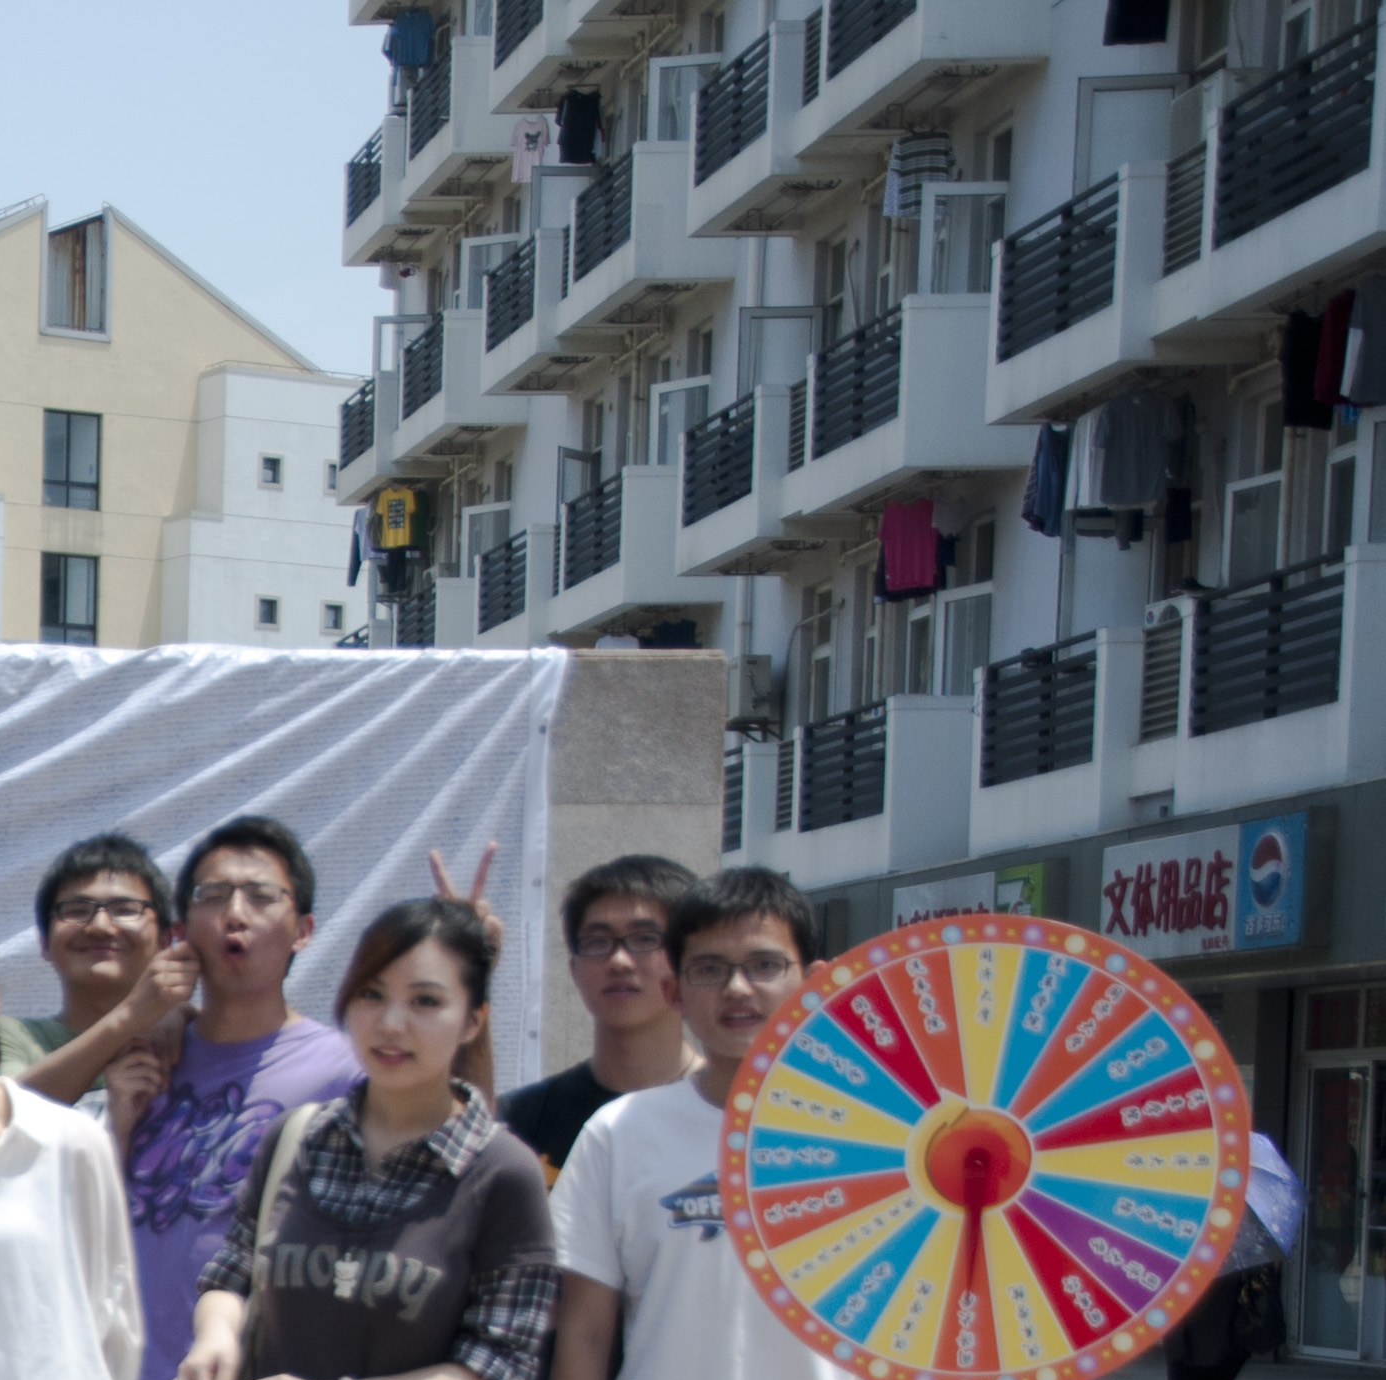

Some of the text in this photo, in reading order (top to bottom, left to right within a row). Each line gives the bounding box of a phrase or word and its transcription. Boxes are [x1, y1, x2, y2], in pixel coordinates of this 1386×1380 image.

[1103, 849, 1233, 938] 文体用品店
